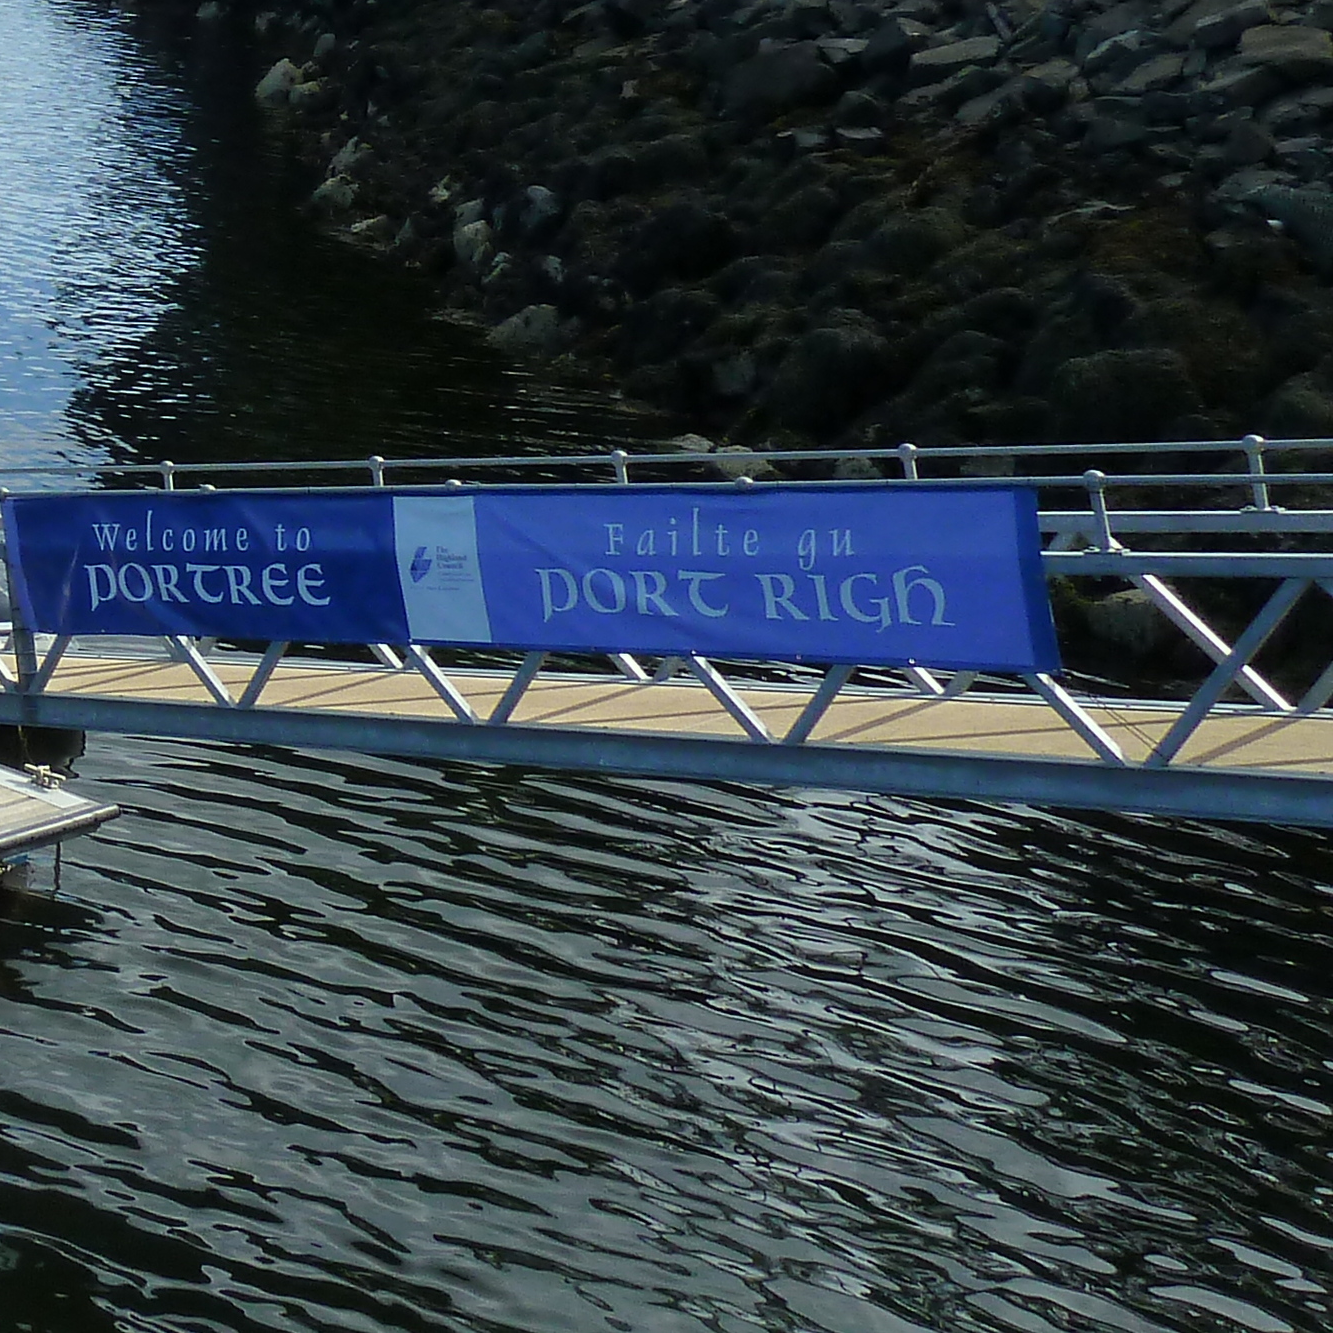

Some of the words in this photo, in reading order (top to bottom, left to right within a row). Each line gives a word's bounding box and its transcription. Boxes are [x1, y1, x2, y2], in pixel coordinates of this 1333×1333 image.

[92, 510, 249, 552] Welcome
[275, 524, 311, 551] to
[603, 507, 759, 556] Failte
[798, 529, 855, 571] gu
[84, 563, 331, 612] PORTREE
[534, 568, 729, 623] PORT
[754, 565, 956, 633] RIGH
